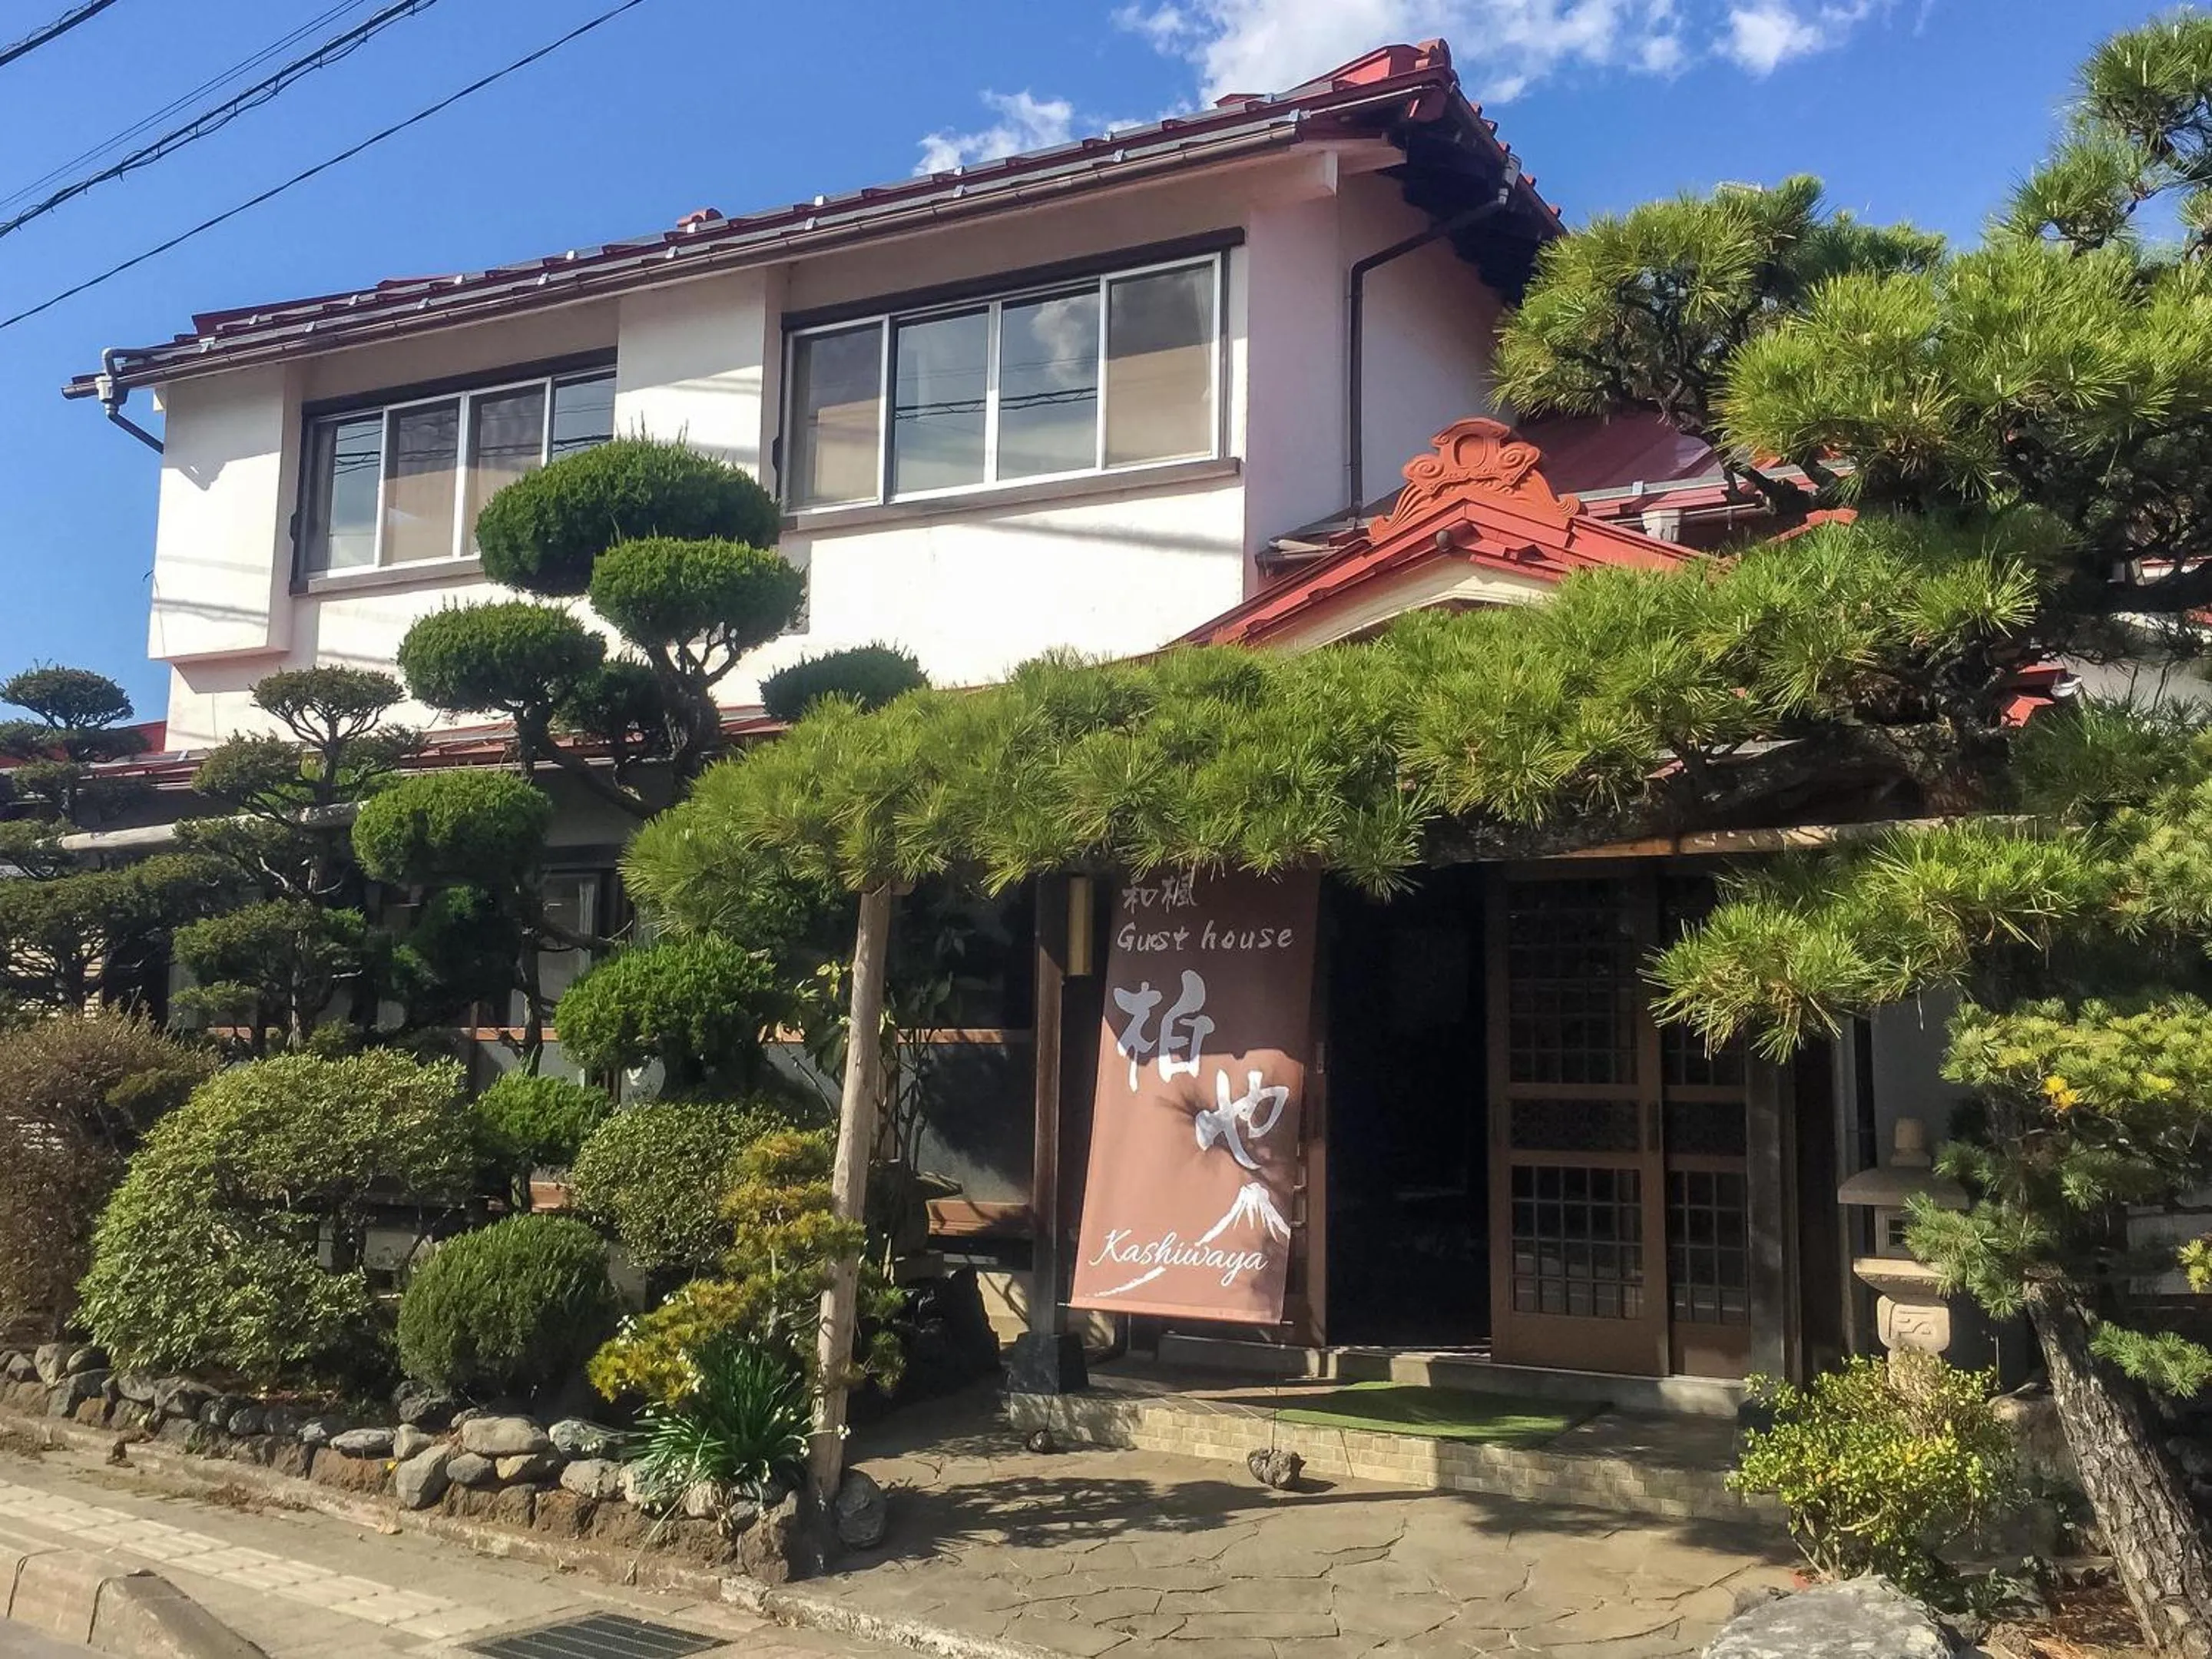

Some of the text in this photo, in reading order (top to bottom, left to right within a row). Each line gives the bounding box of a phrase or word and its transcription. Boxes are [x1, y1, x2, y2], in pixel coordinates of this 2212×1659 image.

[1118, 920, 1294, 952] Guest house
[1088, 1228, 1269, 1286] Kashiwaya
